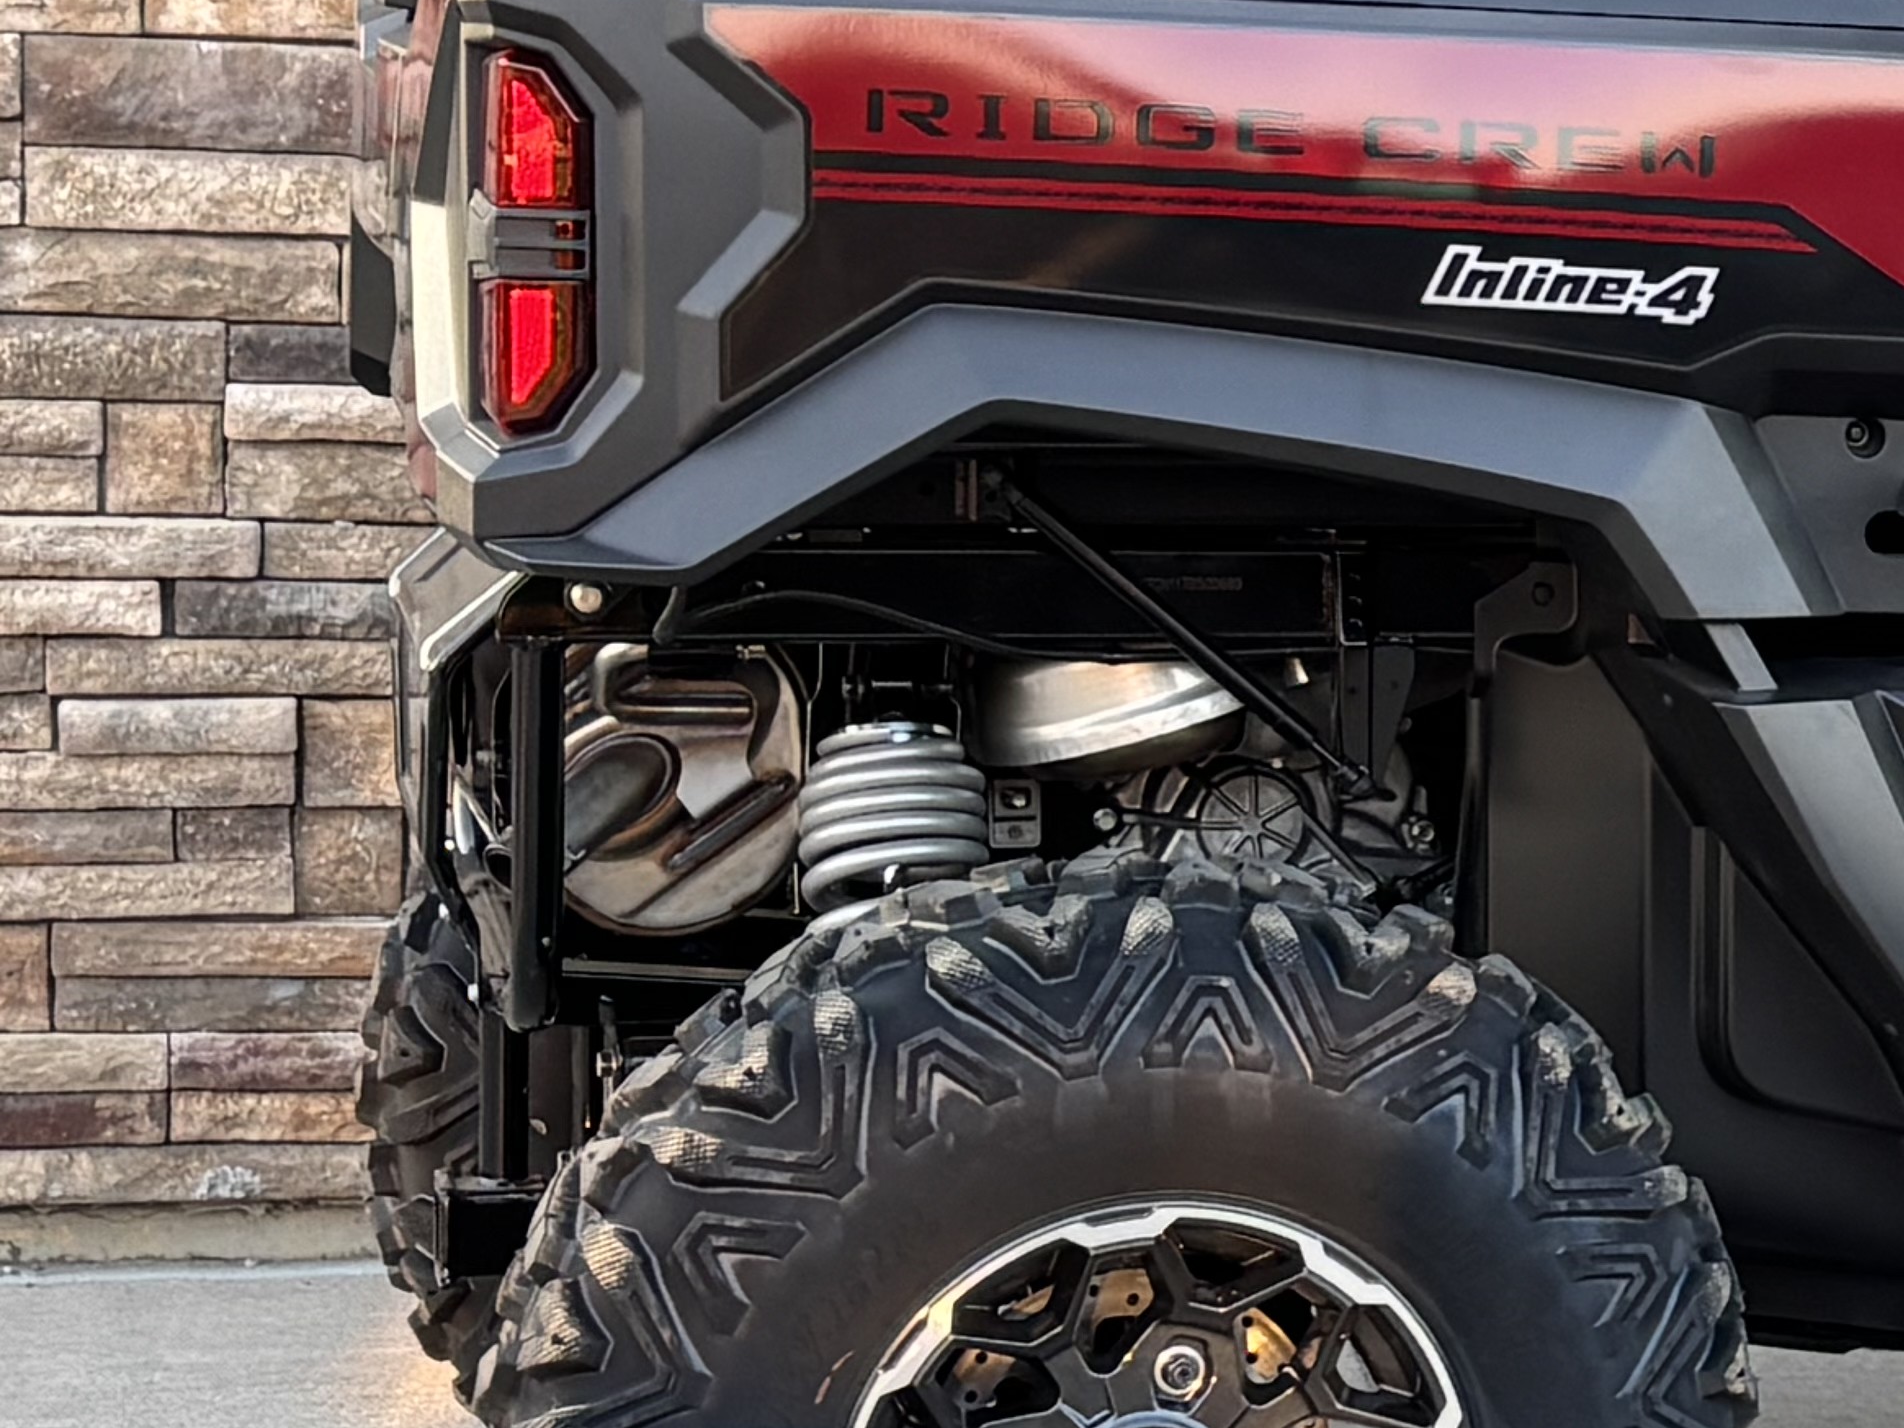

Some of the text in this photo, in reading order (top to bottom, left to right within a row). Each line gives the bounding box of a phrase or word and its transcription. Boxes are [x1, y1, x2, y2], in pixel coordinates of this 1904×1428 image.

[866, 88, 1717, 178] RIDGE CREW
[1421, 244, 1720, 326] Inline-4
